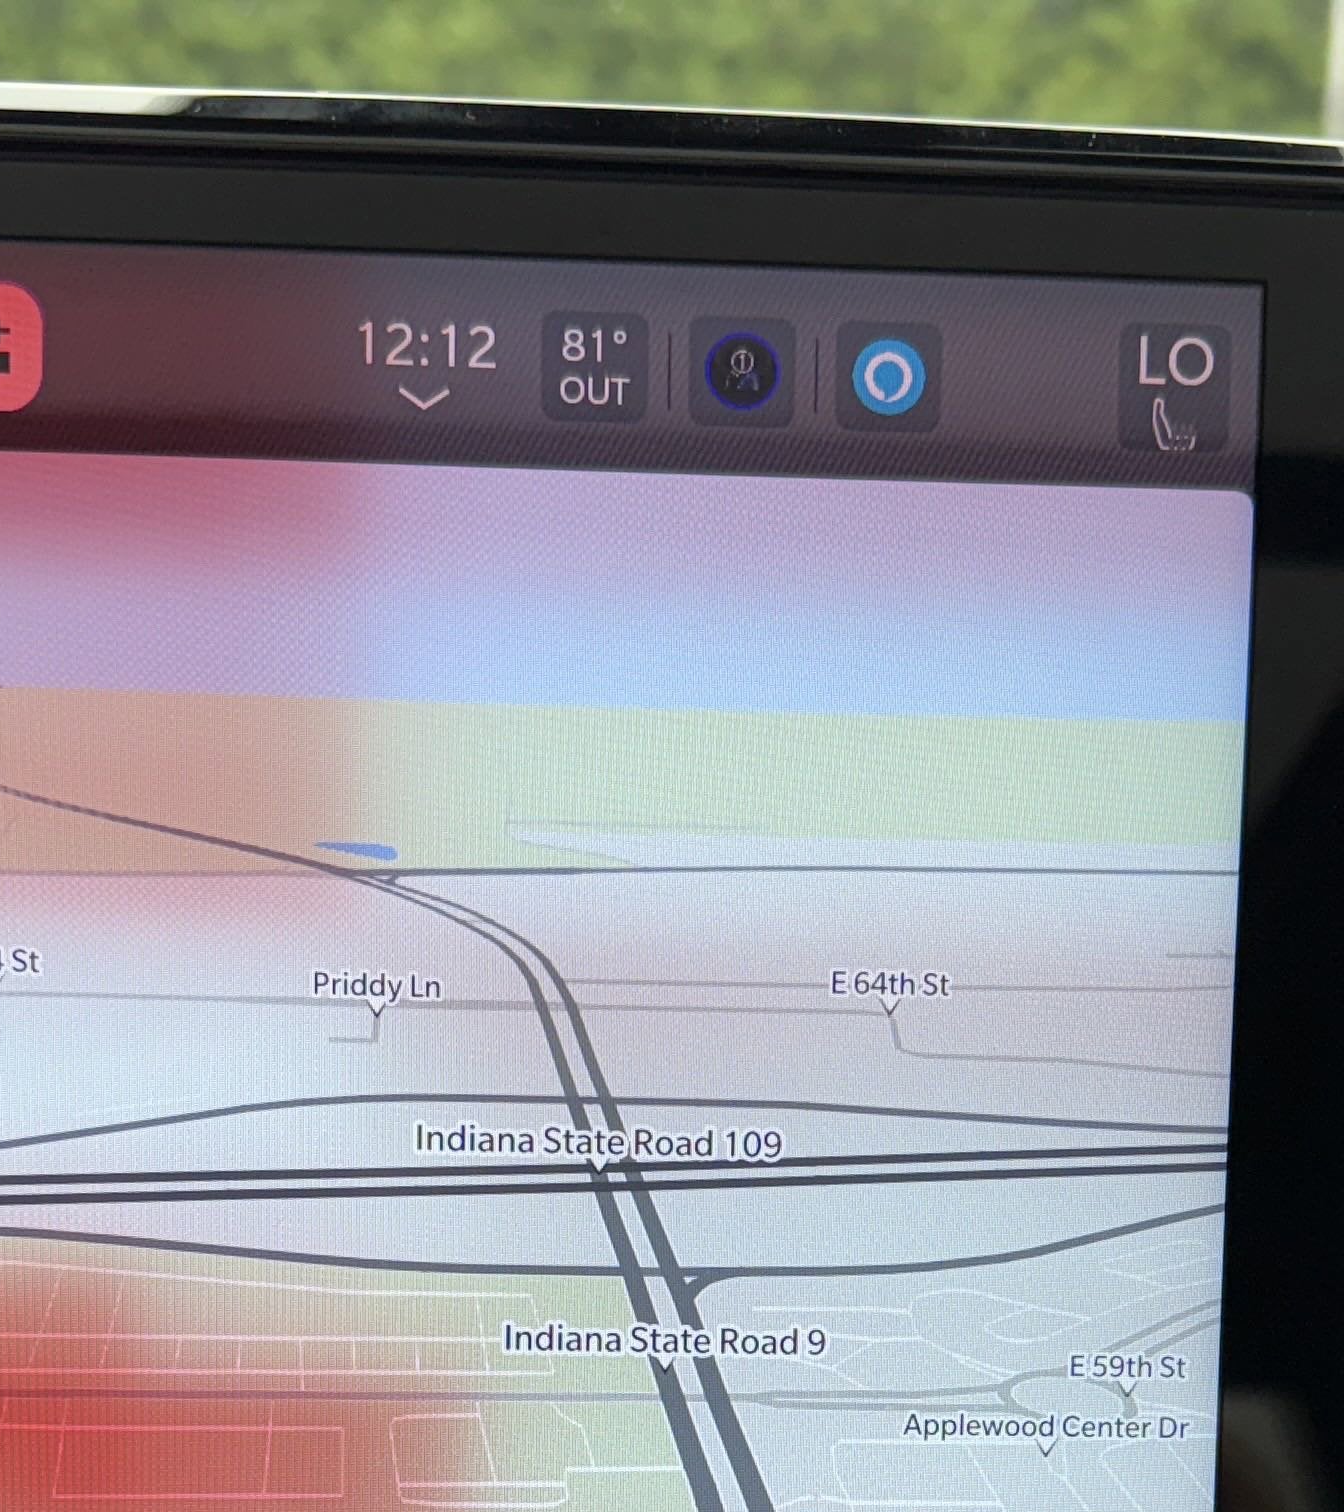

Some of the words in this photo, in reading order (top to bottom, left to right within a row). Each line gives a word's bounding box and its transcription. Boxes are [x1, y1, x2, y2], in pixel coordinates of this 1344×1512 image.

[358, 320, 497, 369] 12:12
[561, 328, 628, 363] 81°
[1139, 334, 1215, 388] LO
[559, 375, 631, 406] OUT
[12, 948, 40, 973] St
[313, 972, 403, 1003] Priddy
[410, 974, 441, 998] Ln
[832, 971, 847, 994] E
[854, 971, 915, 995] 64th
[923, 972, 949, 996] St
[416, 1124, 534, 1153] Indiana
[543, 1127, 625, 1155] State
[634, 1129, 713, 1157] Road
[726, 1131, 782, 1157] 109
[505, 1324, 622, 1352] Indiana
[630, 1326, 711, 1354] State
[720, 1328, 799, 1355] Road
[808, 1329, 826, 1355] 9
[1070, 1356, 1085, 1377] E
[1092, 1356, 1153, 1378] 59th
[1159, 1356, 1187, 1379] St
[903, 1414, 1055, 1441] Applewood
[1062, 1415, 1152, 1439] Center
[1159, 1417, 1190, 1439] Dr
